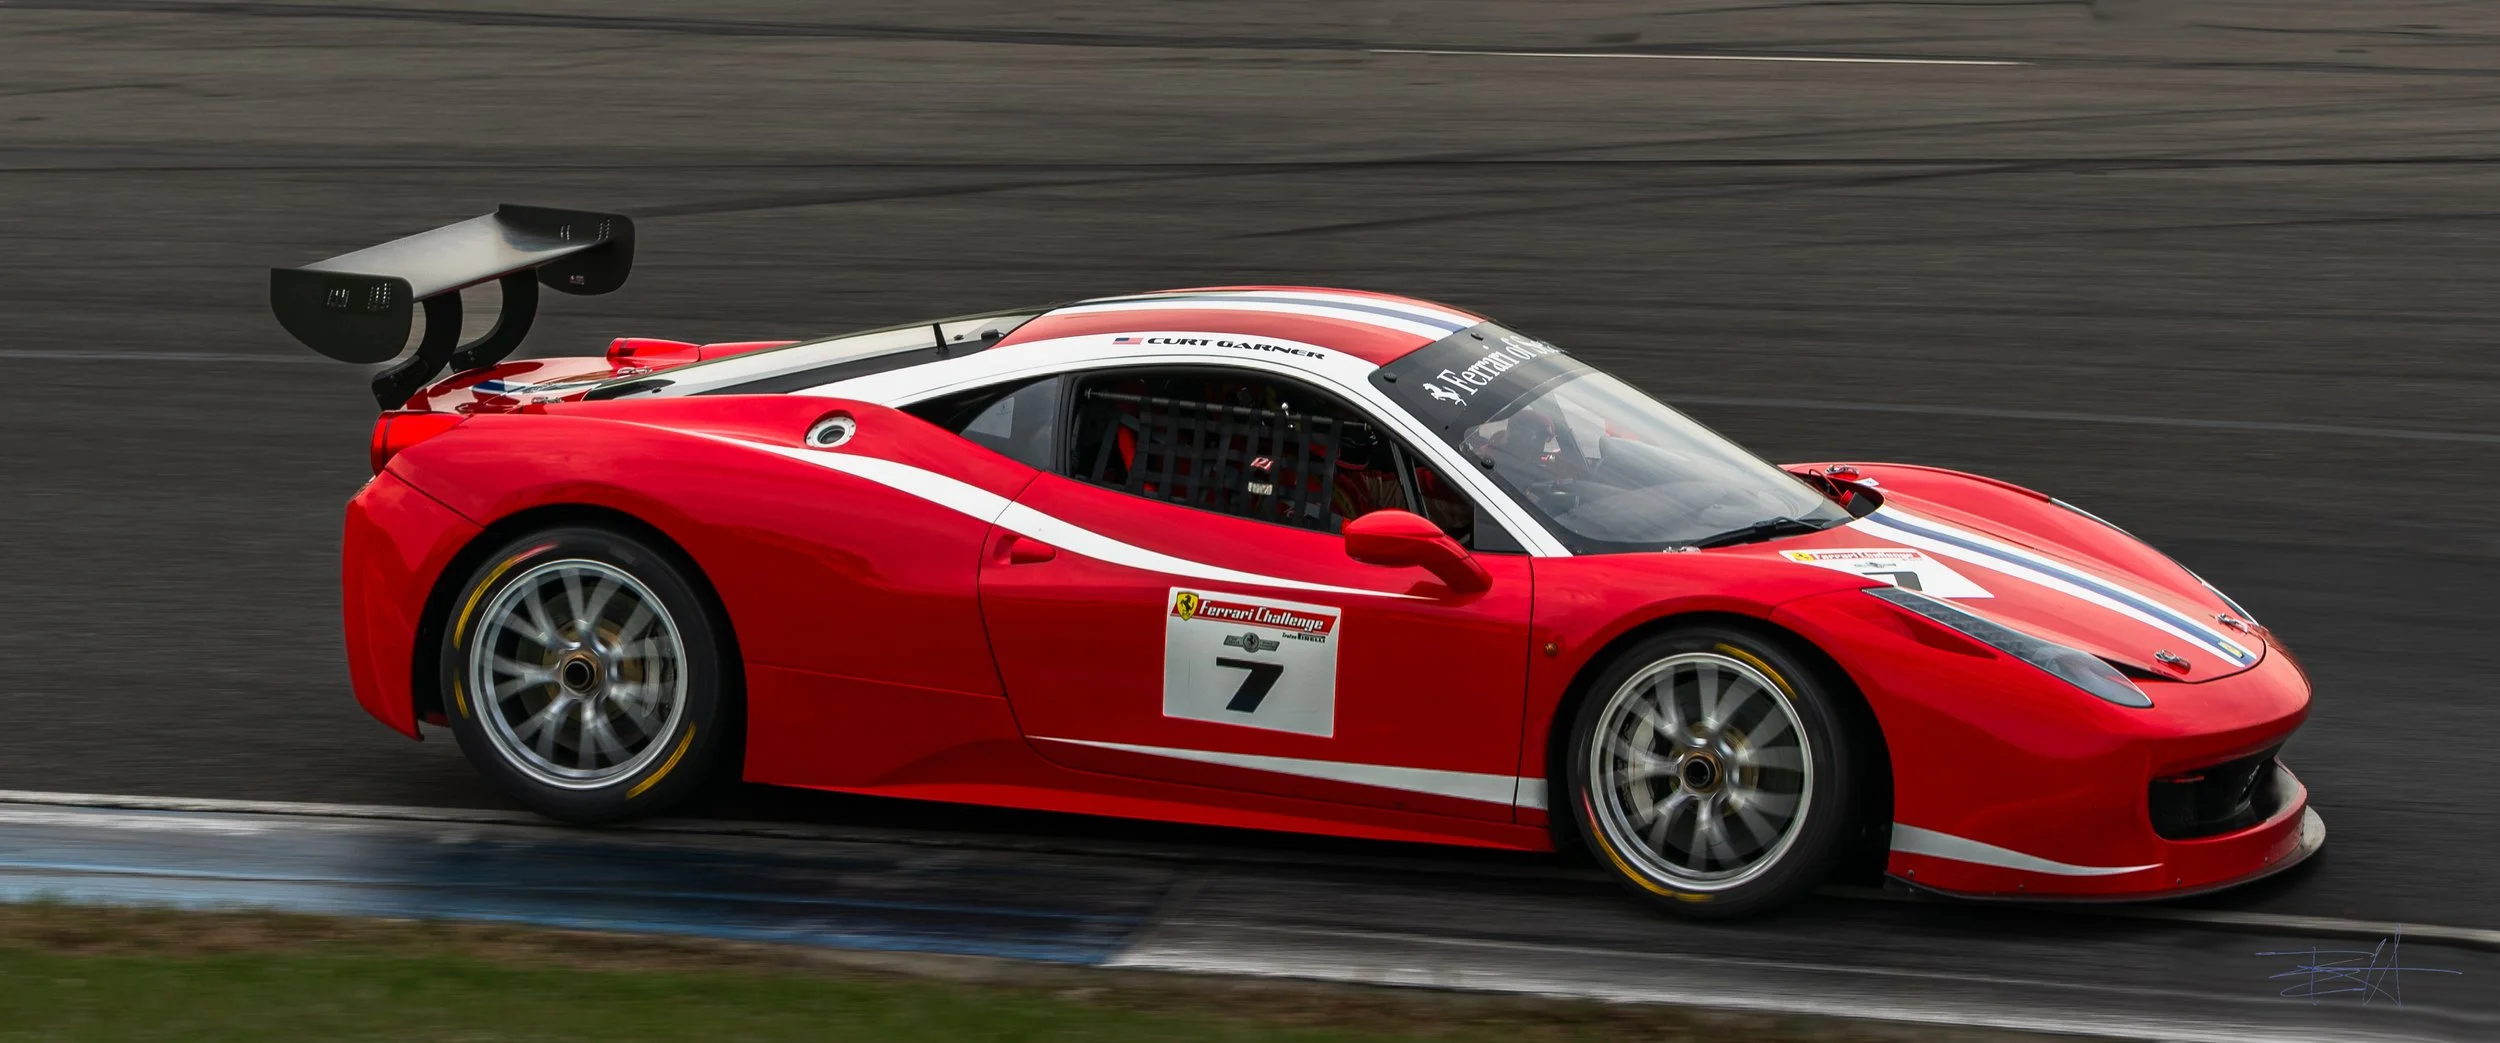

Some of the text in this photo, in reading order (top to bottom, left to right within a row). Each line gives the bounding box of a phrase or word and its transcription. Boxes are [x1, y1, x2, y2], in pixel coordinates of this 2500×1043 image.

[1147, 337, 1325, 360] CURT GARNER
[1436, 344, 1520, 396] Ferrari
[1199, 600, 1324, 632] Ferrari Challenge
[1216, 656, 1284, 714] 7
